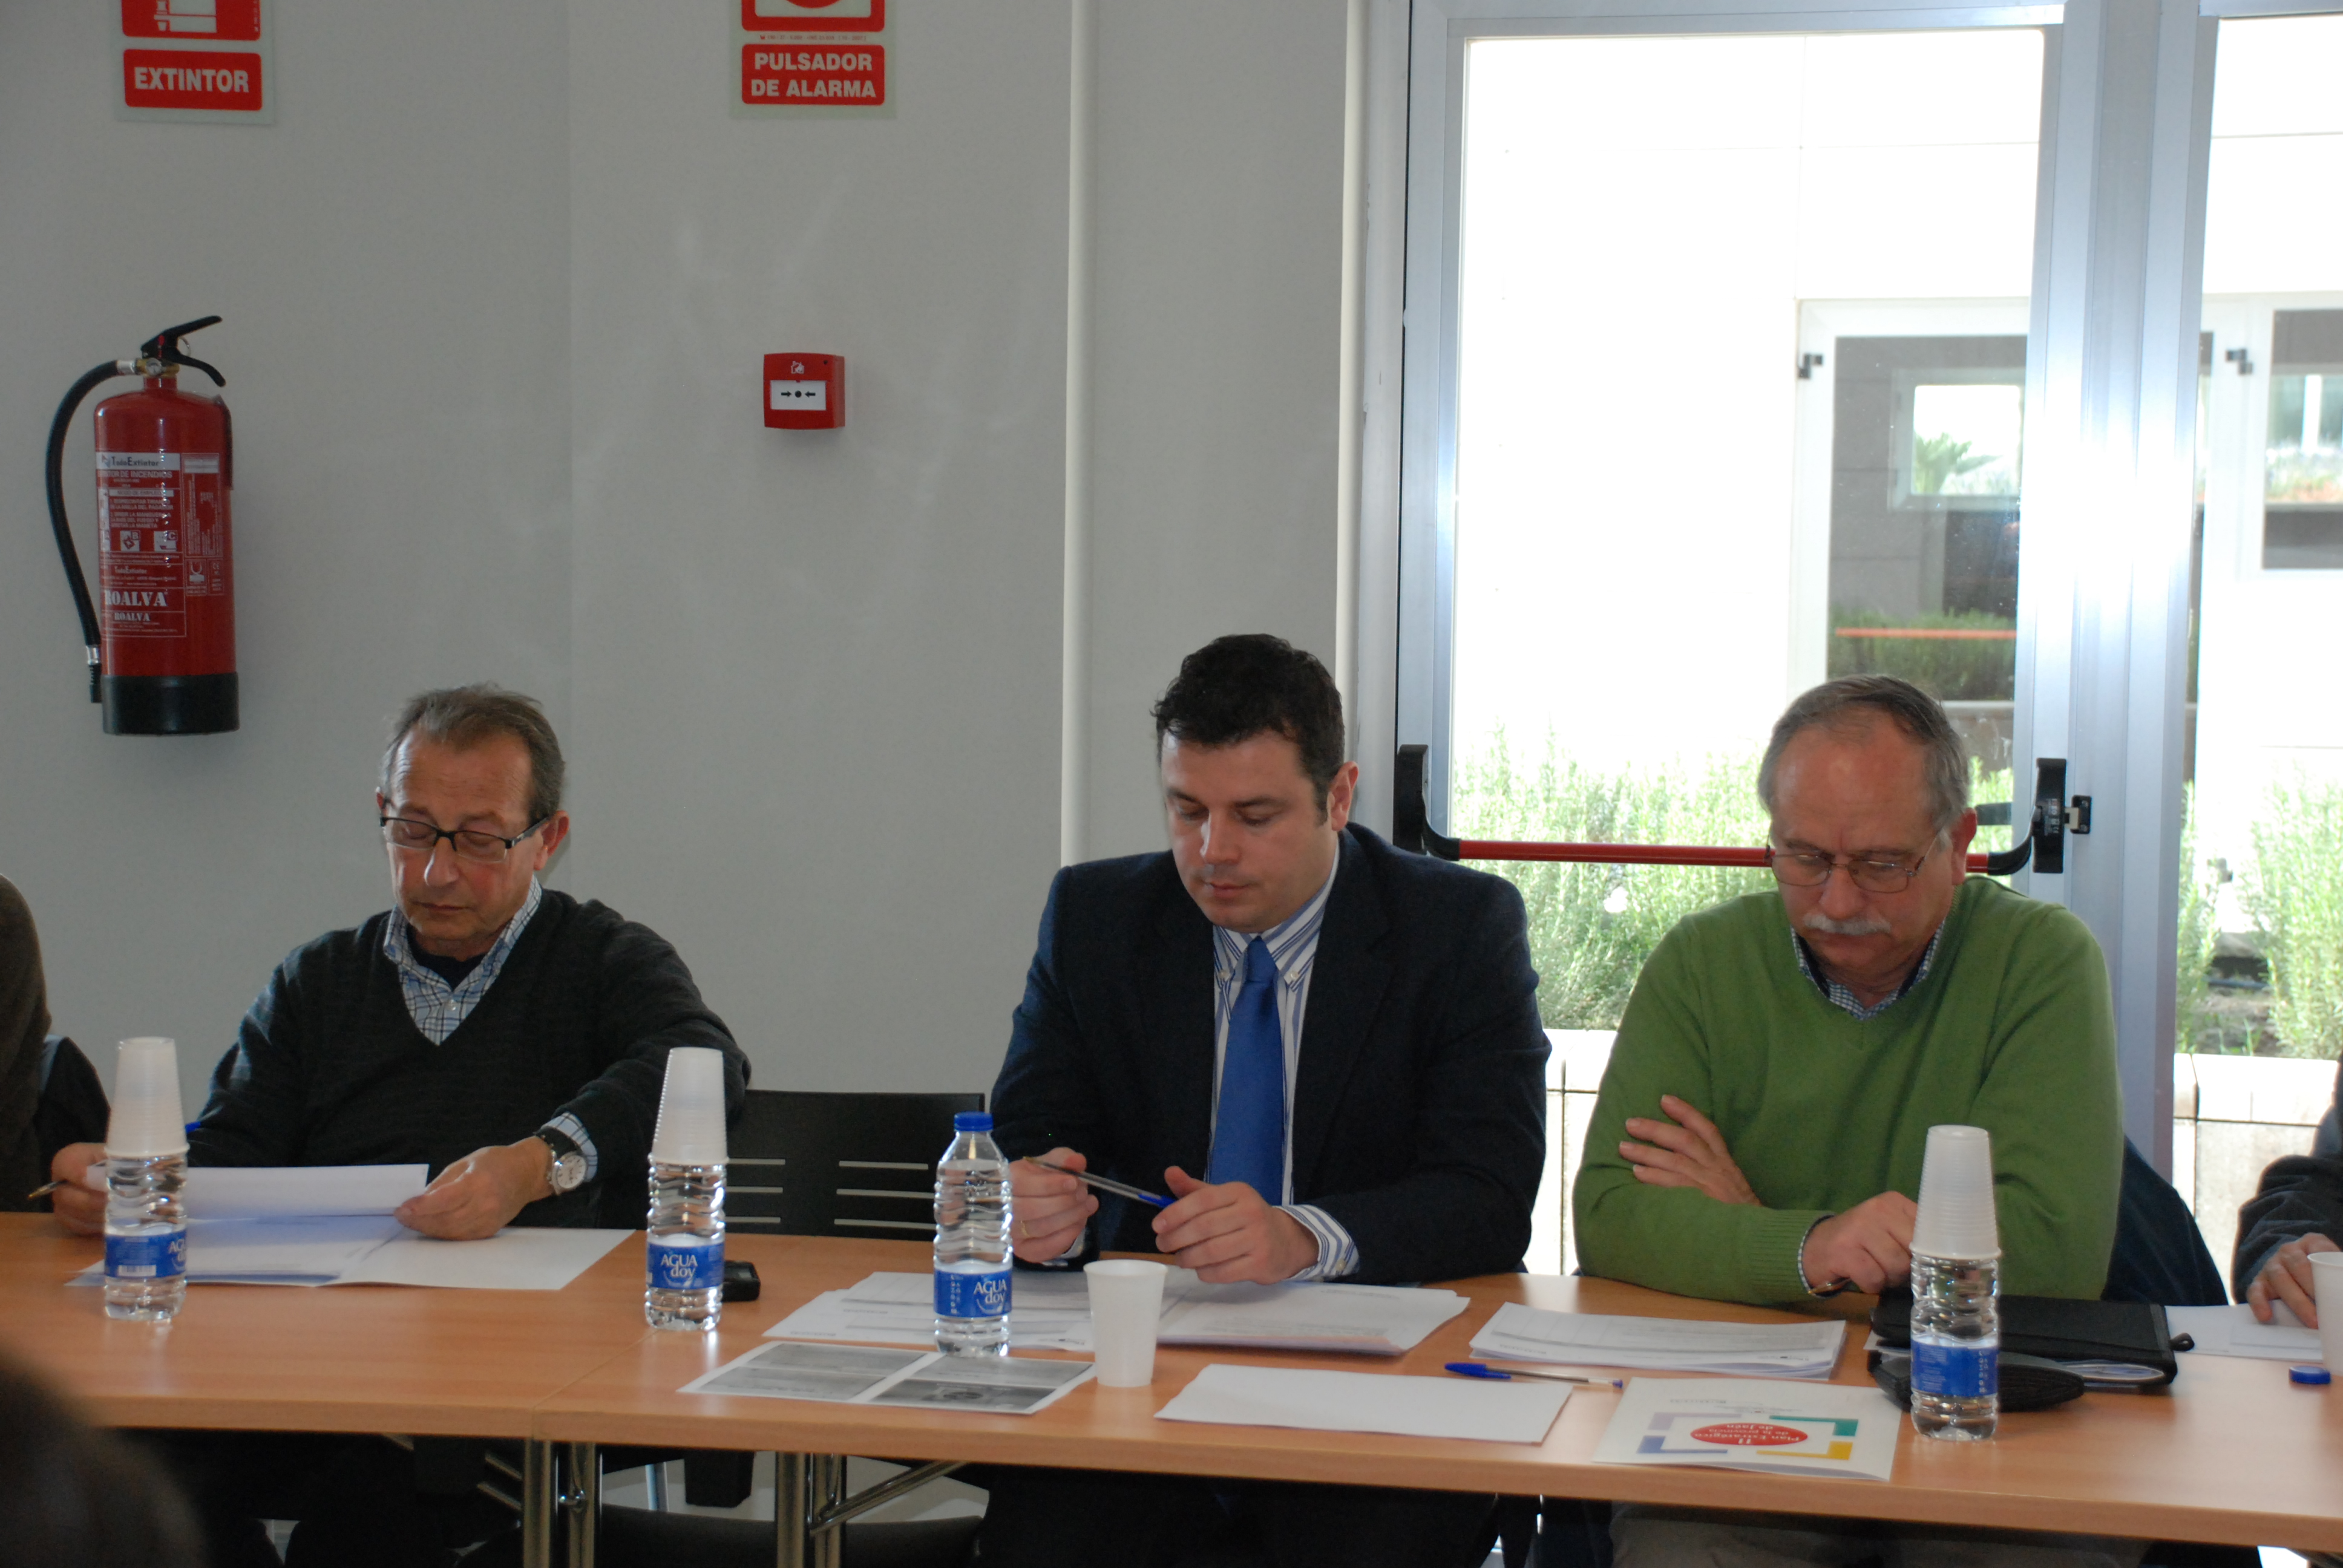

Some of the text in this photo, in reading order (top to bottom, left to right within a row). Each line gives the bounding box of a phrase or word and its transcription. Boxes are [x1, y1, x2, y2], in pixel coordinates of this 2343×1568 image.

[755, 52, 873, 71] PULSADOR
[134, 67, 249, 93] EXTINTOR
[751, 79, 877, 98] DE ALARMA
[105, 589, 168, 607] ROALVA
[660, 1254, 698, 1267] AGUA
[671, 1261, 696, 1279] doy
[973, 1279, 1007, 1295] AGUA
